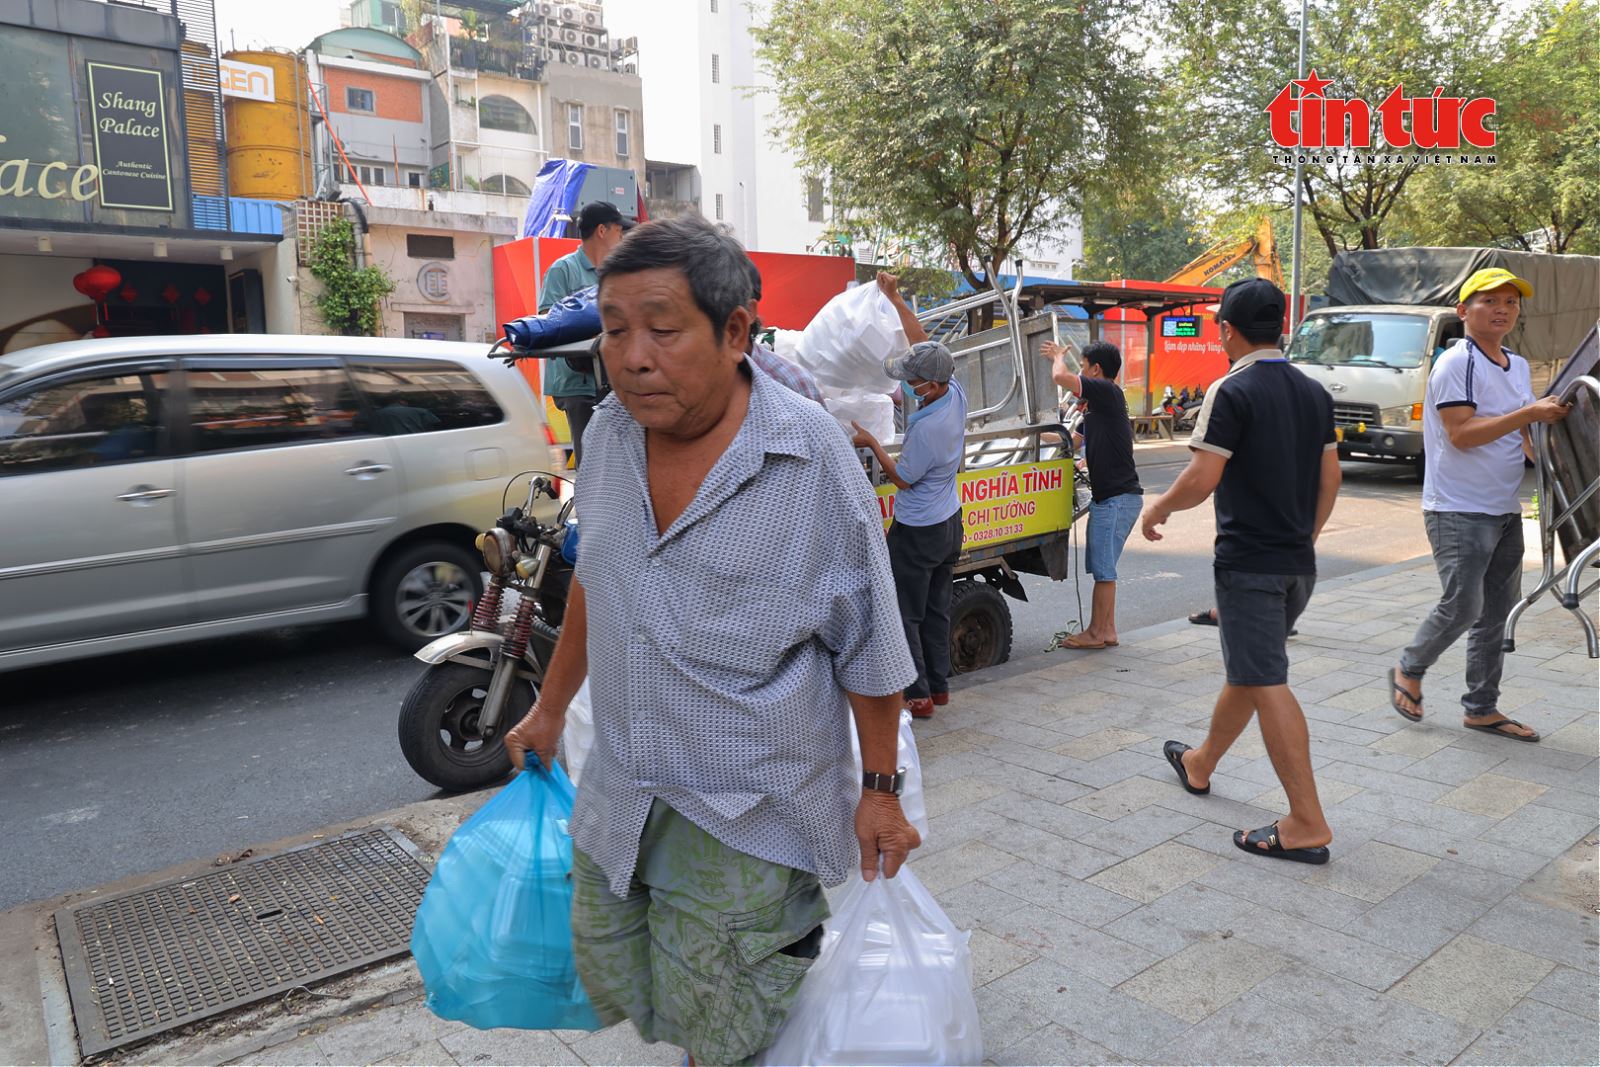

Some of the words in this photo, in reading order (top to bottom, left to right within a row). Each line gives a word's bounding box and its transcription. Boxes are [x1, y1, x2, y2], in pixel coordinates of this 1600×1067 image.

[99, 92, 156, 118] Shang
[100, 117, 160, 138] Palace
[0, 134, 99, 201] ace
[102, 168, 140, 178] Cantonese
[140, 171, 167, 180] Cuisine
[115, 160, 153, 170] Authentic
[961, 471, 1019, 504] NGHĨA
[1022, 467, 1062, 493] TÌNH
[967, 508, 990, 526] CHỊ
[992, 500, 1036, 522] TƯỜNG
